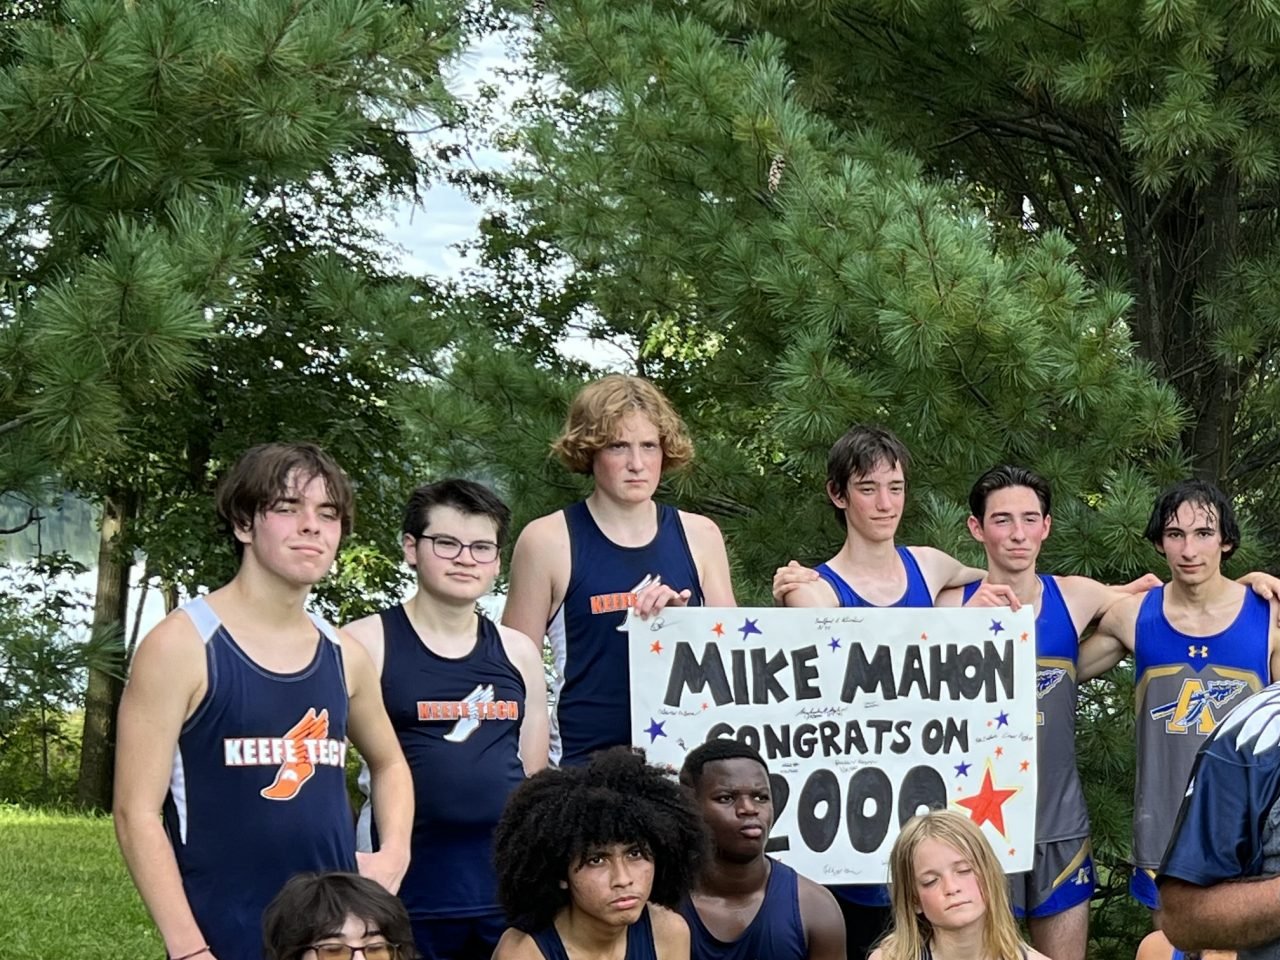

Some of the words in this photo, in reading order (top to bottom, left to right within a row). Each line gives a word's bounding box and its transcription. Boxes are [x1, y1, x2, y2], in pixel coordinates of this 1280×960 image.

[663, 641, 822, 708] MIKE
[840, 639, 1014, 704] MAHON
[416, 700, 471, 721] KEEFE
[475, 700, 519, 721] TECH
[223, 737, 298, 767] KEEFE
[922, 717, 969, 755] ON
